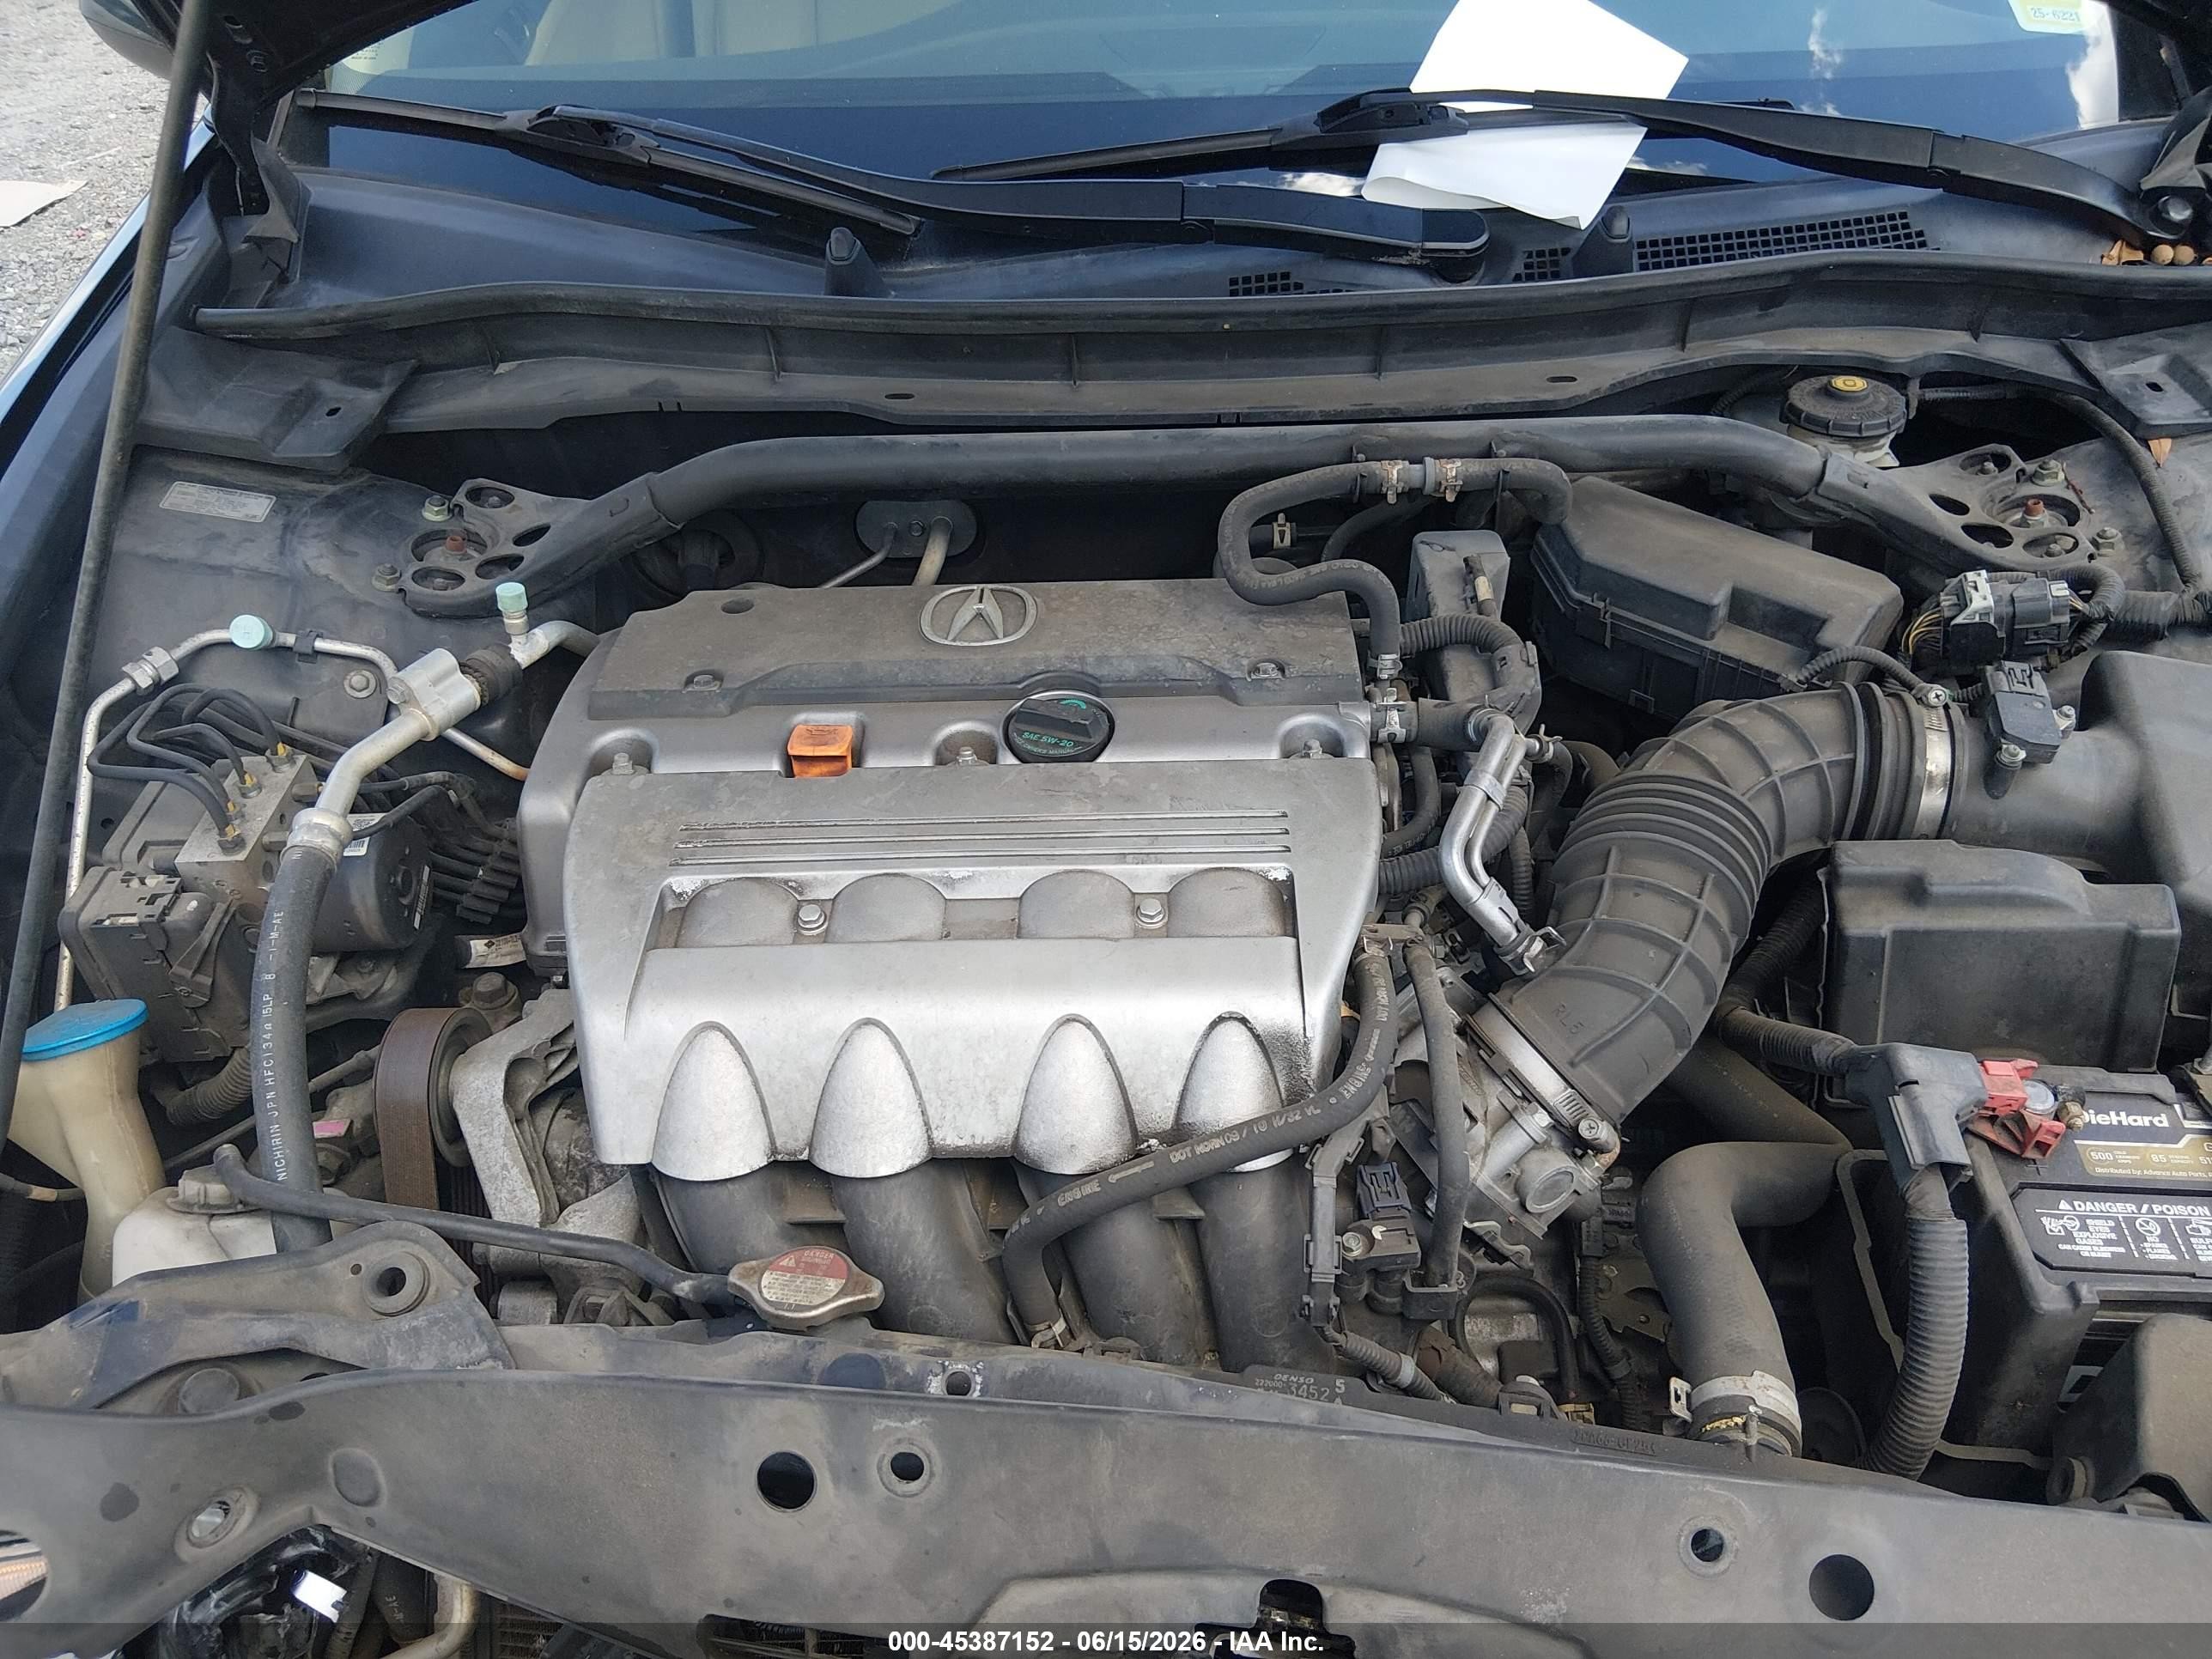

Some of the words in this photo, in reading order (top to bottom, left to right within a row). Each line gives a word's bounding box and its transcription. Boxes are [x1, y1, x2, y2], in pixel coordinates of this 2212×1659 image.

[1022, 731, 1039, 741] SAE
[1040, 734, 1074, 747] 5W-20
[266, 1091, 279, 1117] JPN
[270, 1124, 289, 1181] NICHIRIN
[2090, 1152, 2114, 1161] 500
[2151, 1154, 2167, 1163] 85
[2073, 1201, 2138, 1213] DANGER
[2151, 1204, 2212, 1217] POISON
[1274, 1374, 1315, 1384] DENSO
